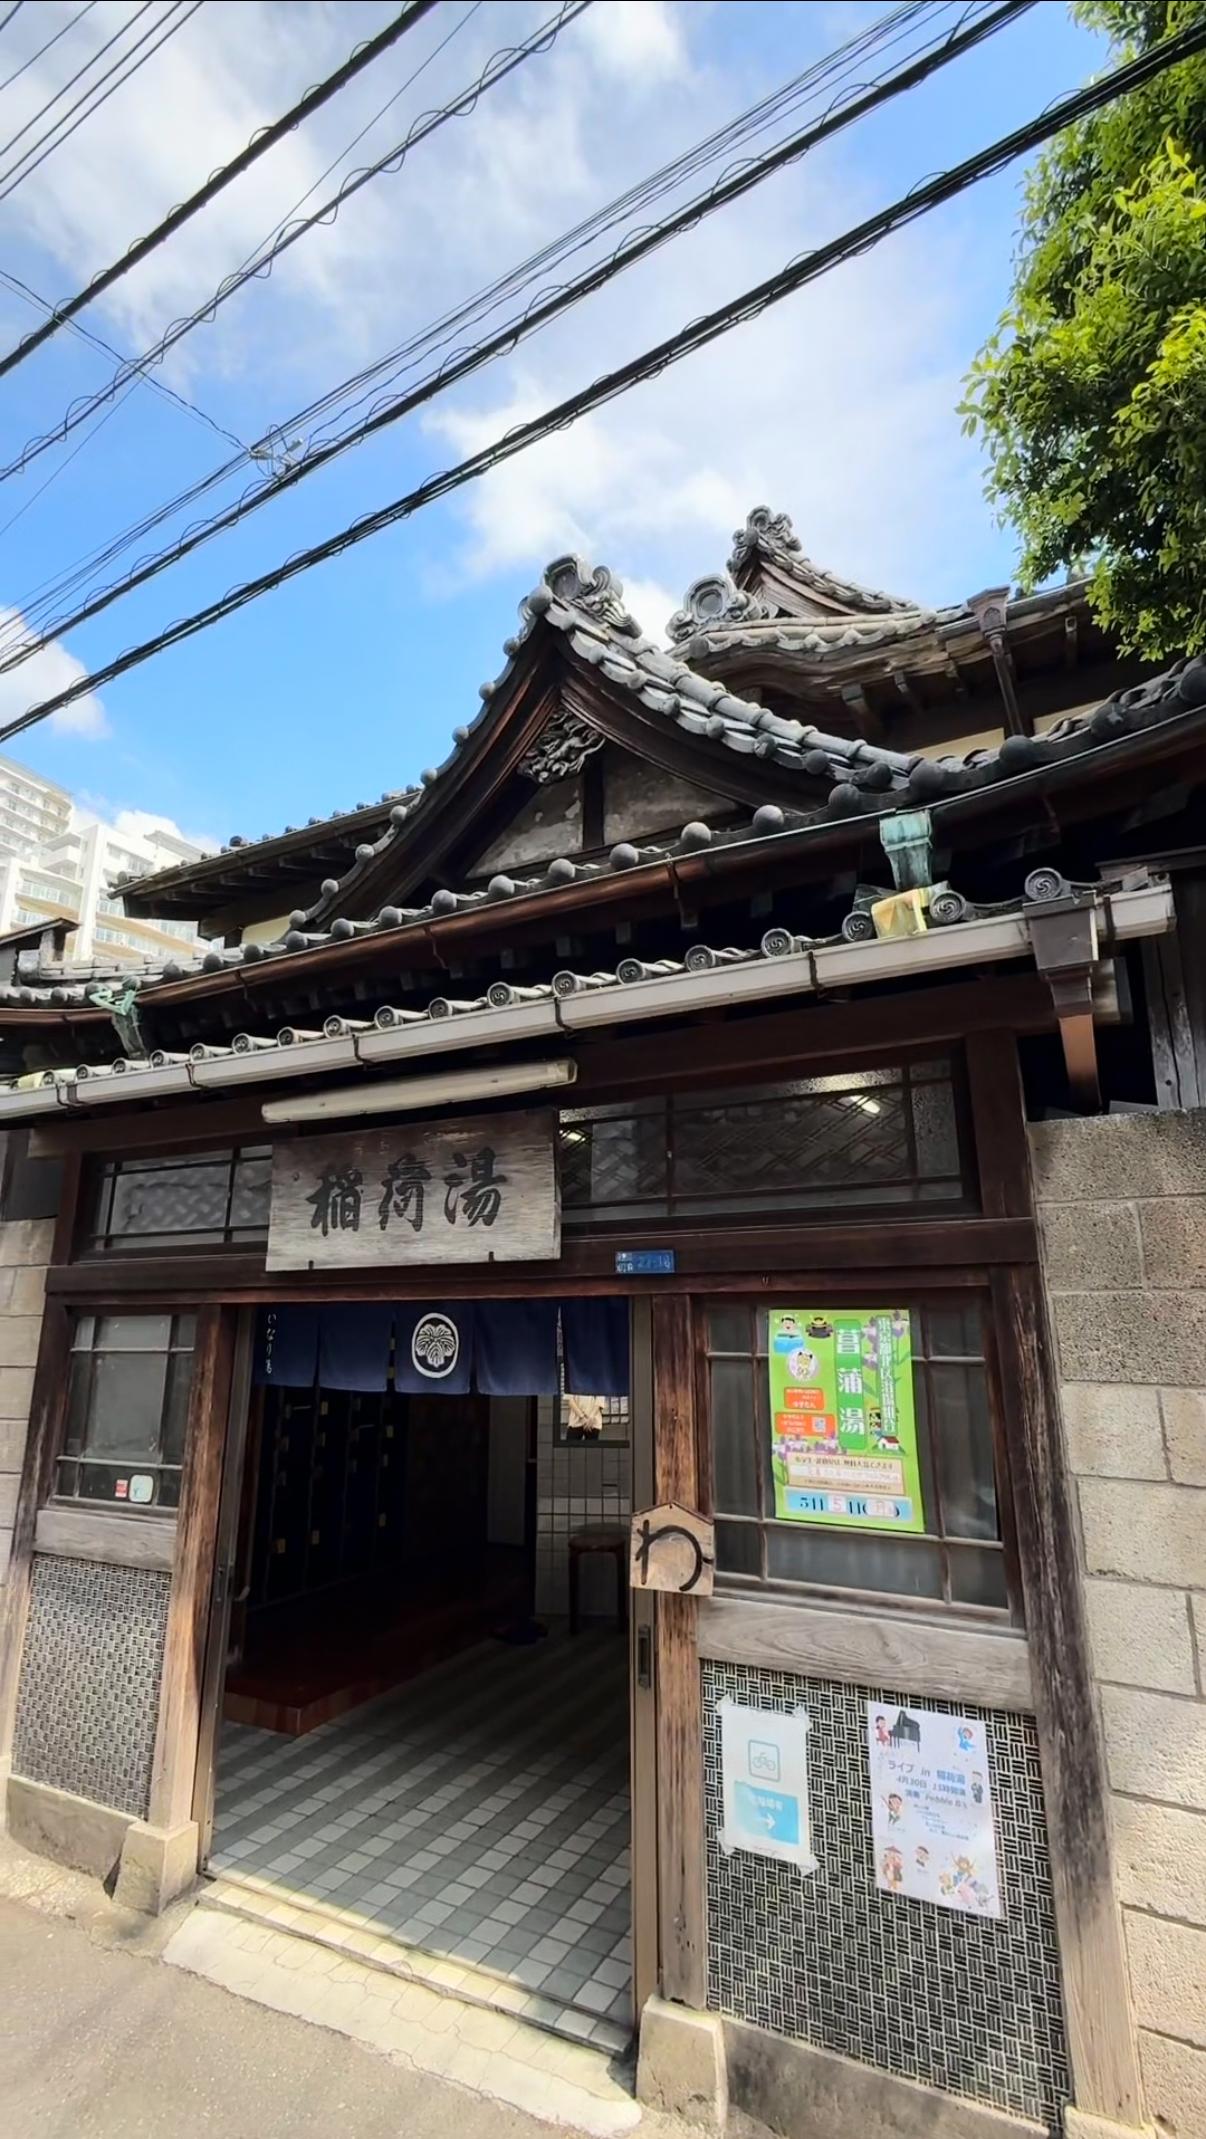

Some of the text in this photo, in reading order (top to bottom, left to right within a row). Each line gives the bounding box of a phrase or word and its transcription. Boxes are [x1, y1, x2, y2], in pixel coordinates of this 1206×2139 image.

[304, 1147, 507, 1237] 稲荷湯
[836, 1328, 864, 1434] 菖蒲湯
[634, 1519, 703, 1592] わ
[888, 1760, 914, 1774] ライブ
[921, 1767, 931, 1777] in
